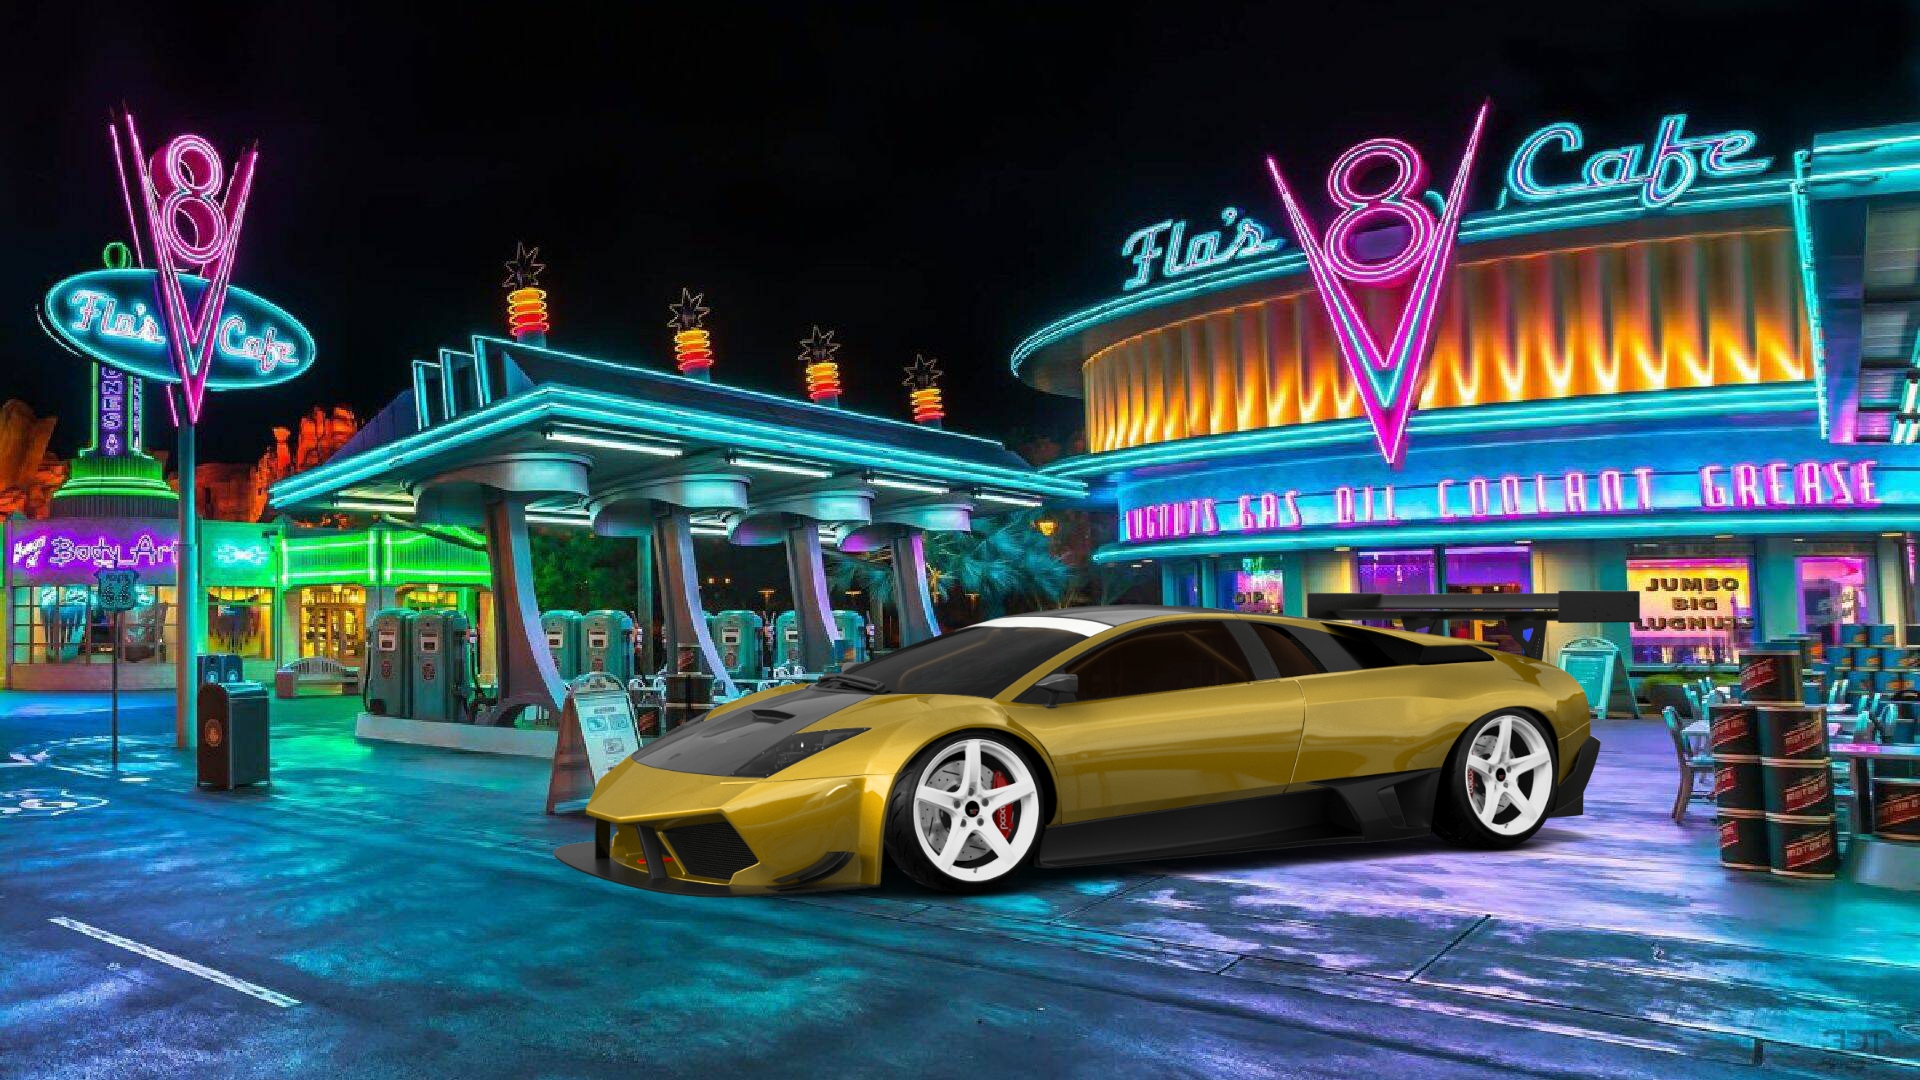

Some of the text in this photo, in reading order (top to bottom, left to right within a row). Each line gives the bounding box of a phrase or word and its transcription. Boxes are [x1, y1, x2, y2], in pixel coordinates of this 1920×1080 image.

[1507, 113, 1774, 209] Cafe
[1122, 206, 1285, 290] Flo's
[70, 290, 166, 343] Flo's
[219, 316, 299, 373] Cafe
[1238, 489, 1302, 529] GAS
[1335, 485, 1399, 524] OIL
[1437, 469, 1653, 519] COOLANT
[1700, 460, 1880, 508] GREASE
[1645, 577, 1740, 592] JUMBO
[1671, 597, 1718, 611] BIG
